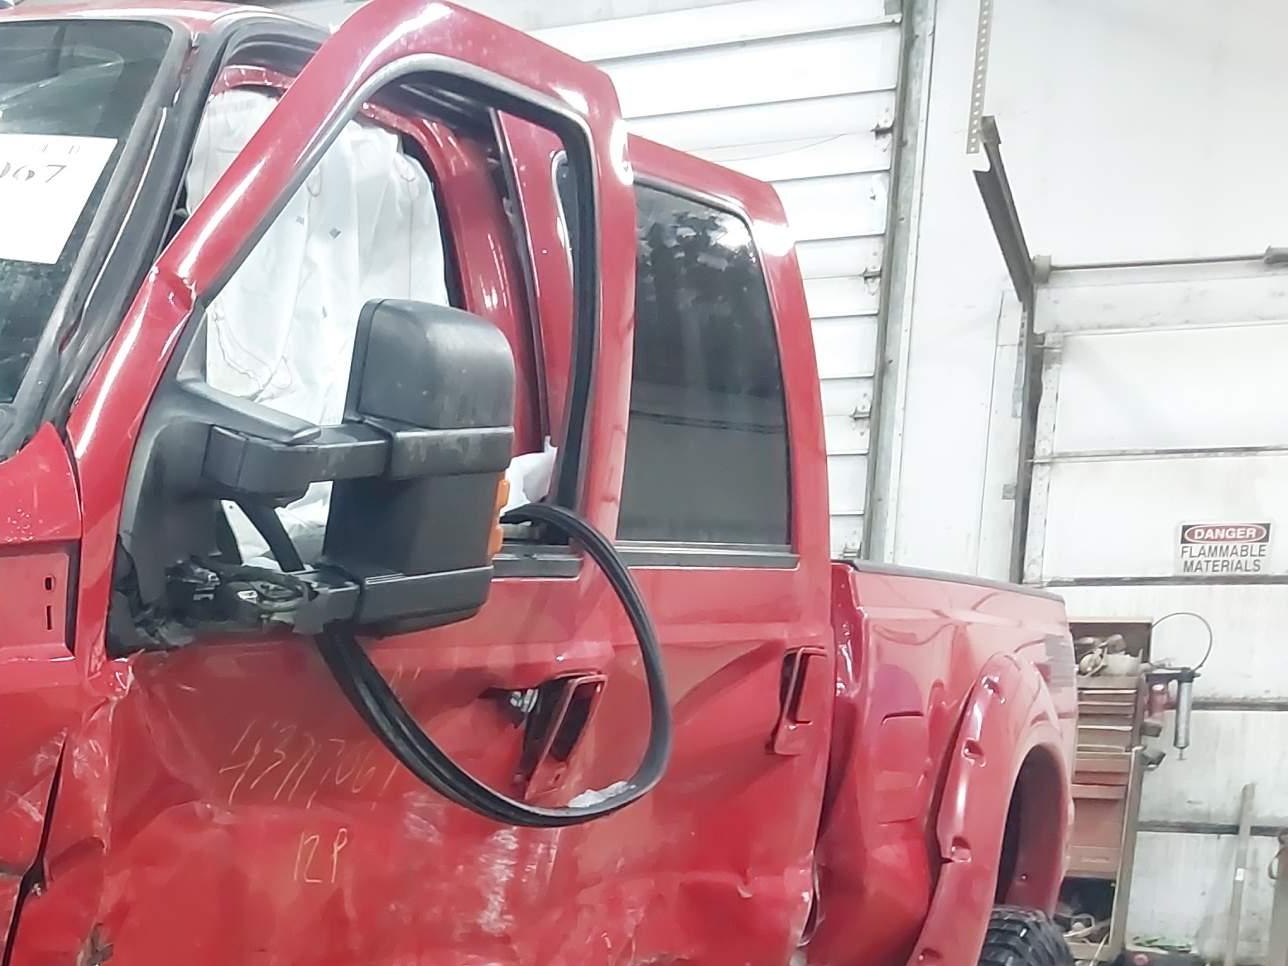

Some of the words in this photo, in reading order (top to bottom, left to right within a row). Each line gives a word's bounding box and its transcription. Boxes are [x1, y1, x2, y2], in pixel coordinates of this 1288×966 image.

[1193, 527, 1257, 540] DANGER
[1181, 544, 1267, 558] FLAMMABLE
[1183, 559, 1262, 573] MATERIALS
